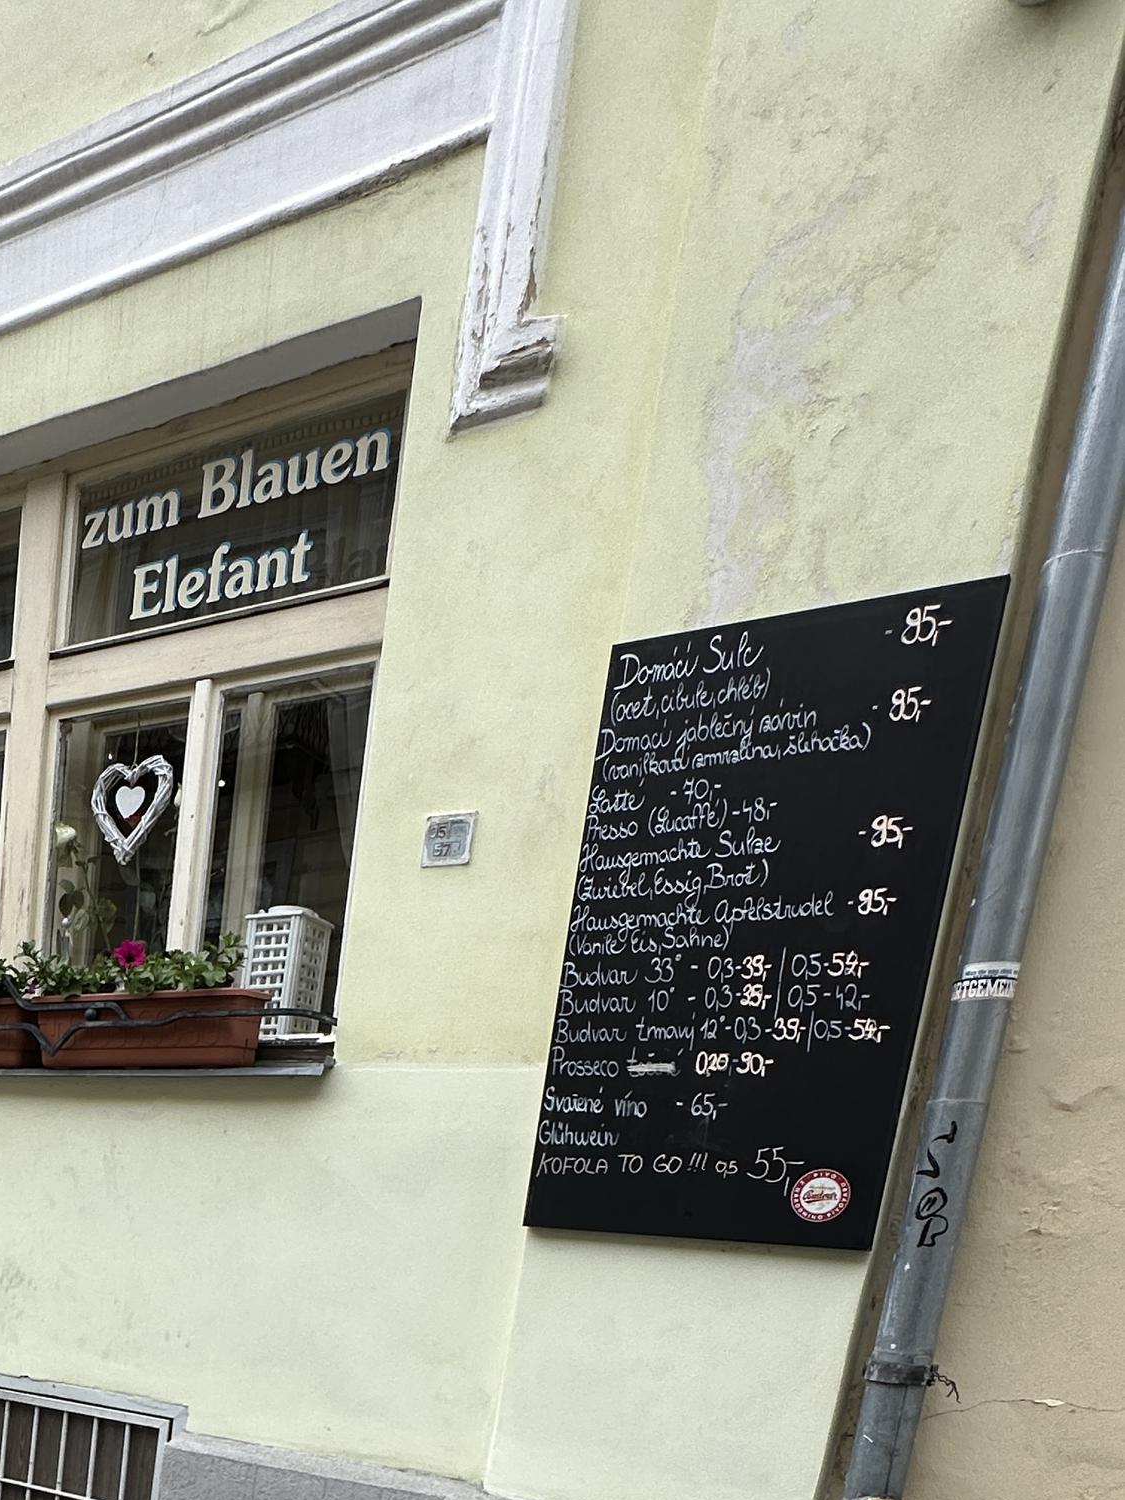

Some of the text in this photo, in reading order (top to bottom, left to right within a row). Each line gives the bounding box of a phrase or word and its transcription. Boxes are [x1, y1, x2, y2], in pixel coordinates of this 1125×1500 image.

[81, 427, 390, 549] zum Blauen
[129, 529, 313, 620] Elefant
[585, 814, 639, 842] Presso
[579, 838, 712, 884] Hausgemachte
[570, 901, 711, 942] Hausgemachte
[714, 890, 835, 935] Apfelstrudel
[560, 961, 638, 988] Budvar
[559, 989, 637, 1016] Budvar
[555, 1018, 627, 1044] Budvar
[551, 1046, 619, 1077] Prosseco
[614, 1089, 649, 1118] víno
[538, 1119, 620, 1147] Glühwein
[536, 1152, 609, 1178] KOFOLA
[617, 1153, 643, 1175] TO
